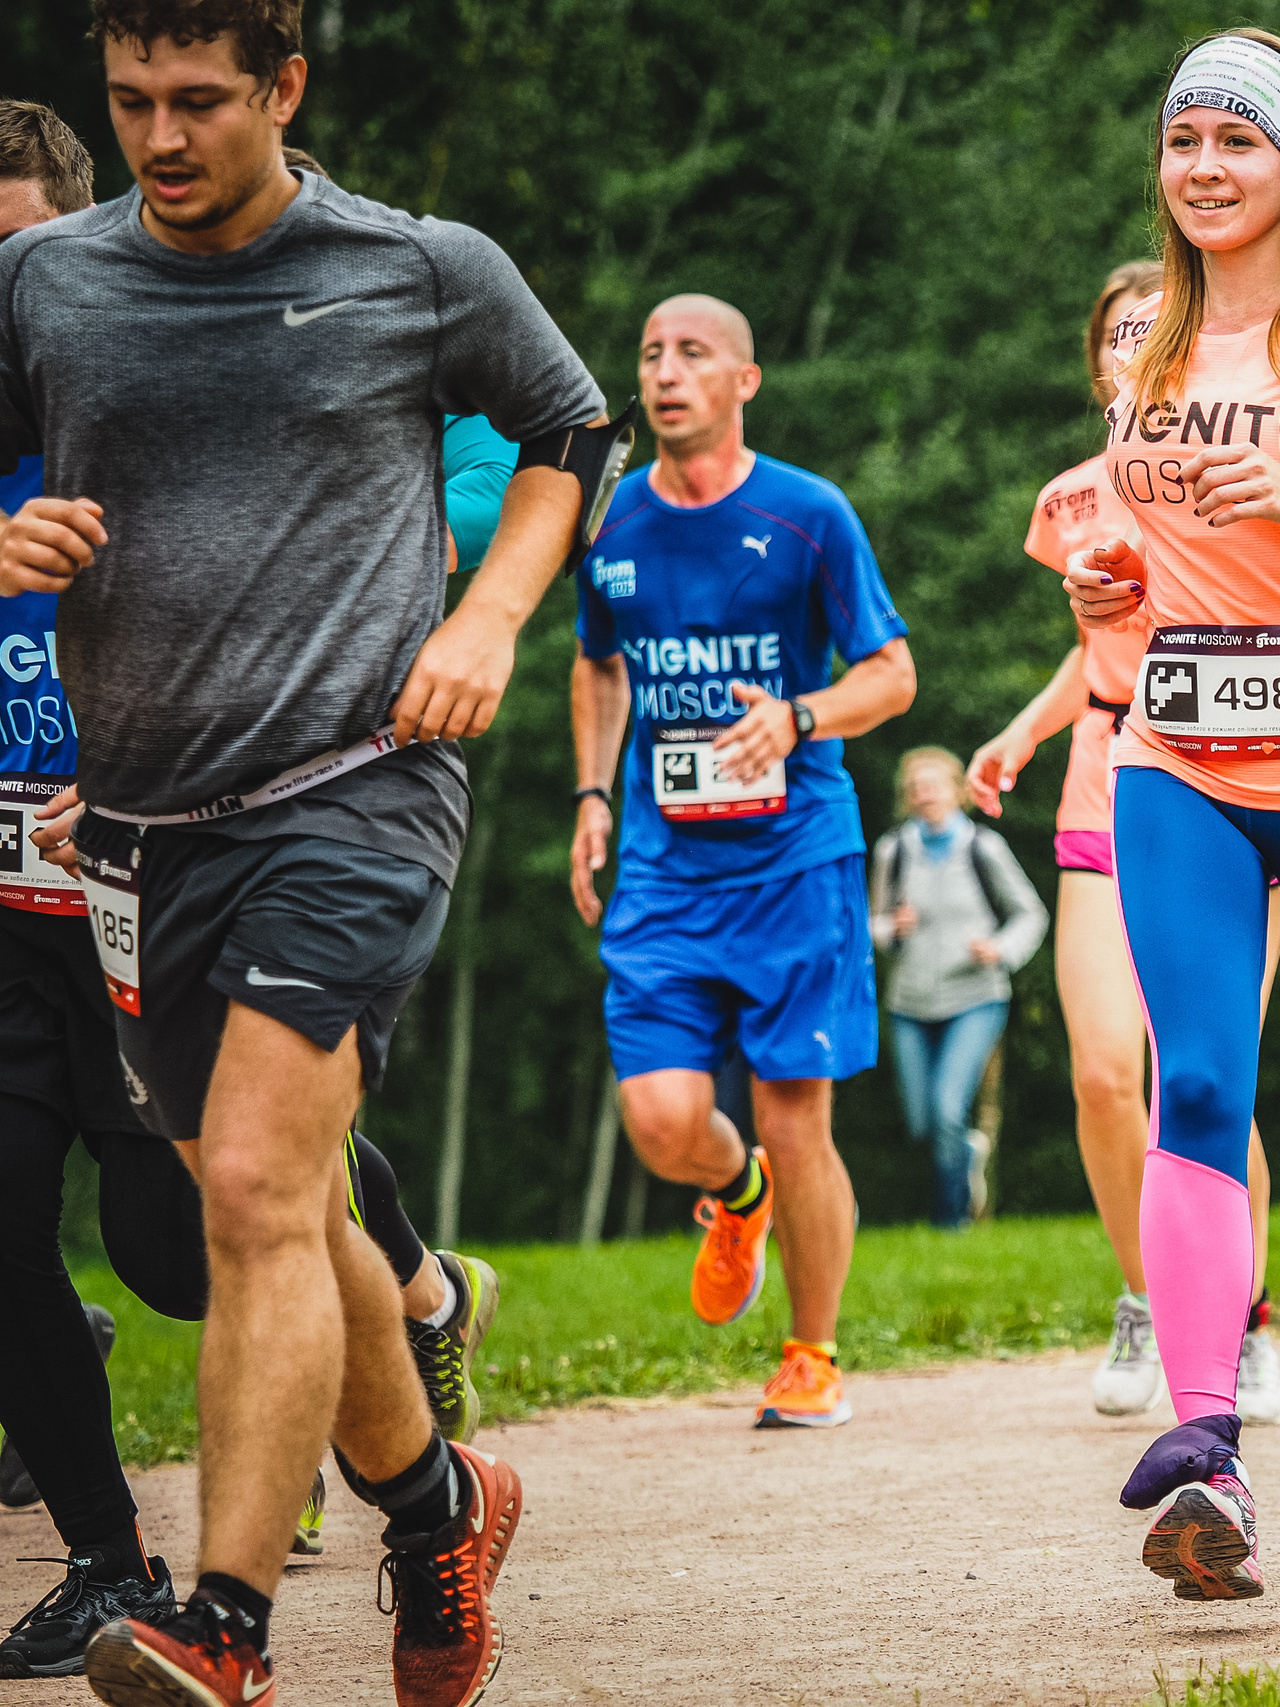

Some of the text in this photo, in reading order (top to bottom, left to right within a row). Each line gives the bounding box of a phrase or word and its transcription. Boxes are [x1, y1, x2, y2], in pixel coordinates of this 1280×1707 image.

[1176, 92, 1195, 111] 50
[1225, 97, 1259, 122] 100
[1199, 634, 1242, 645] MOSCOW
[92, 904, 134, 956] 185
